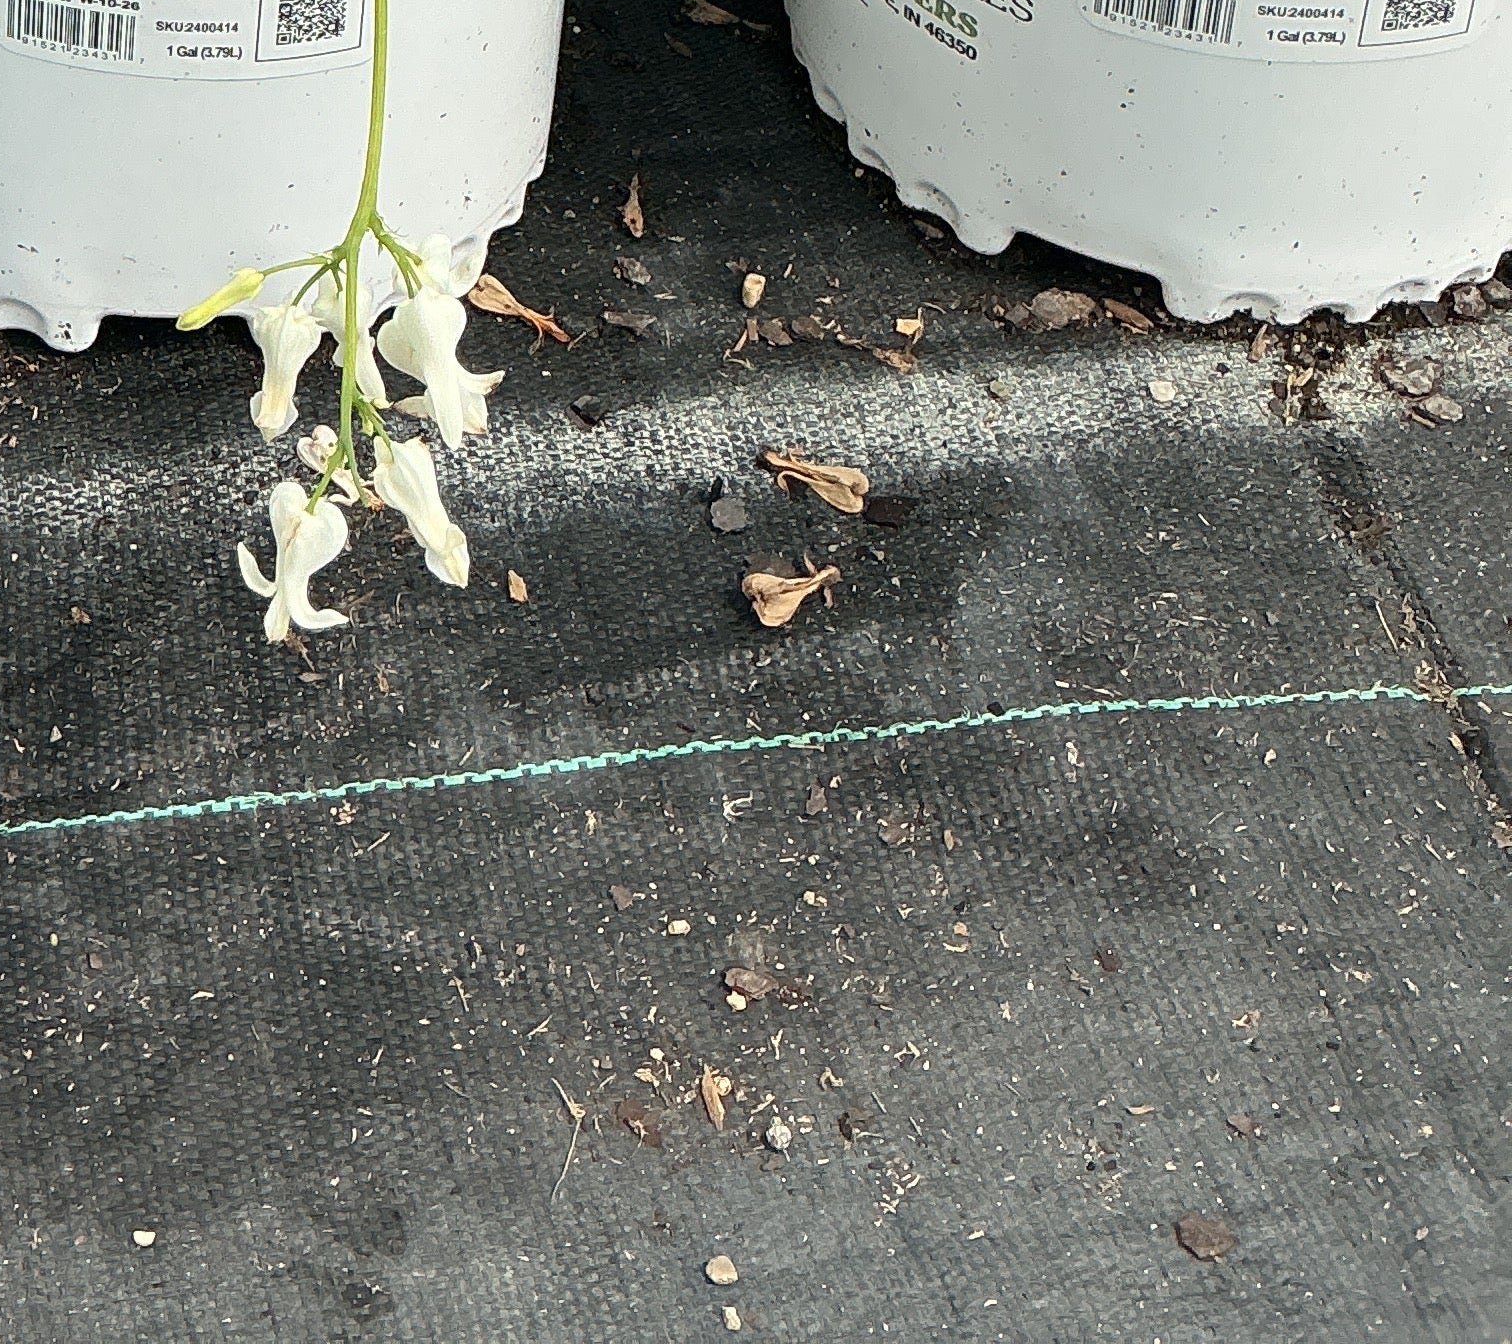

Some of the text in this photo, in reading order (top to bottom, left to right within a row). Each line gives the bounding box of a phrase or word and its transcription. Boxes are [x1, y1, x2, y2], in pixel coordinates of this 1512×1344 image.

[903, 4, 920, 28] IN
[924, 21, 977, 60] 46350
[1266, 30, 1346, 45] 1 Gal (3.79L)
[166, 46, 243, 60] 1 Gal (3.79L)
